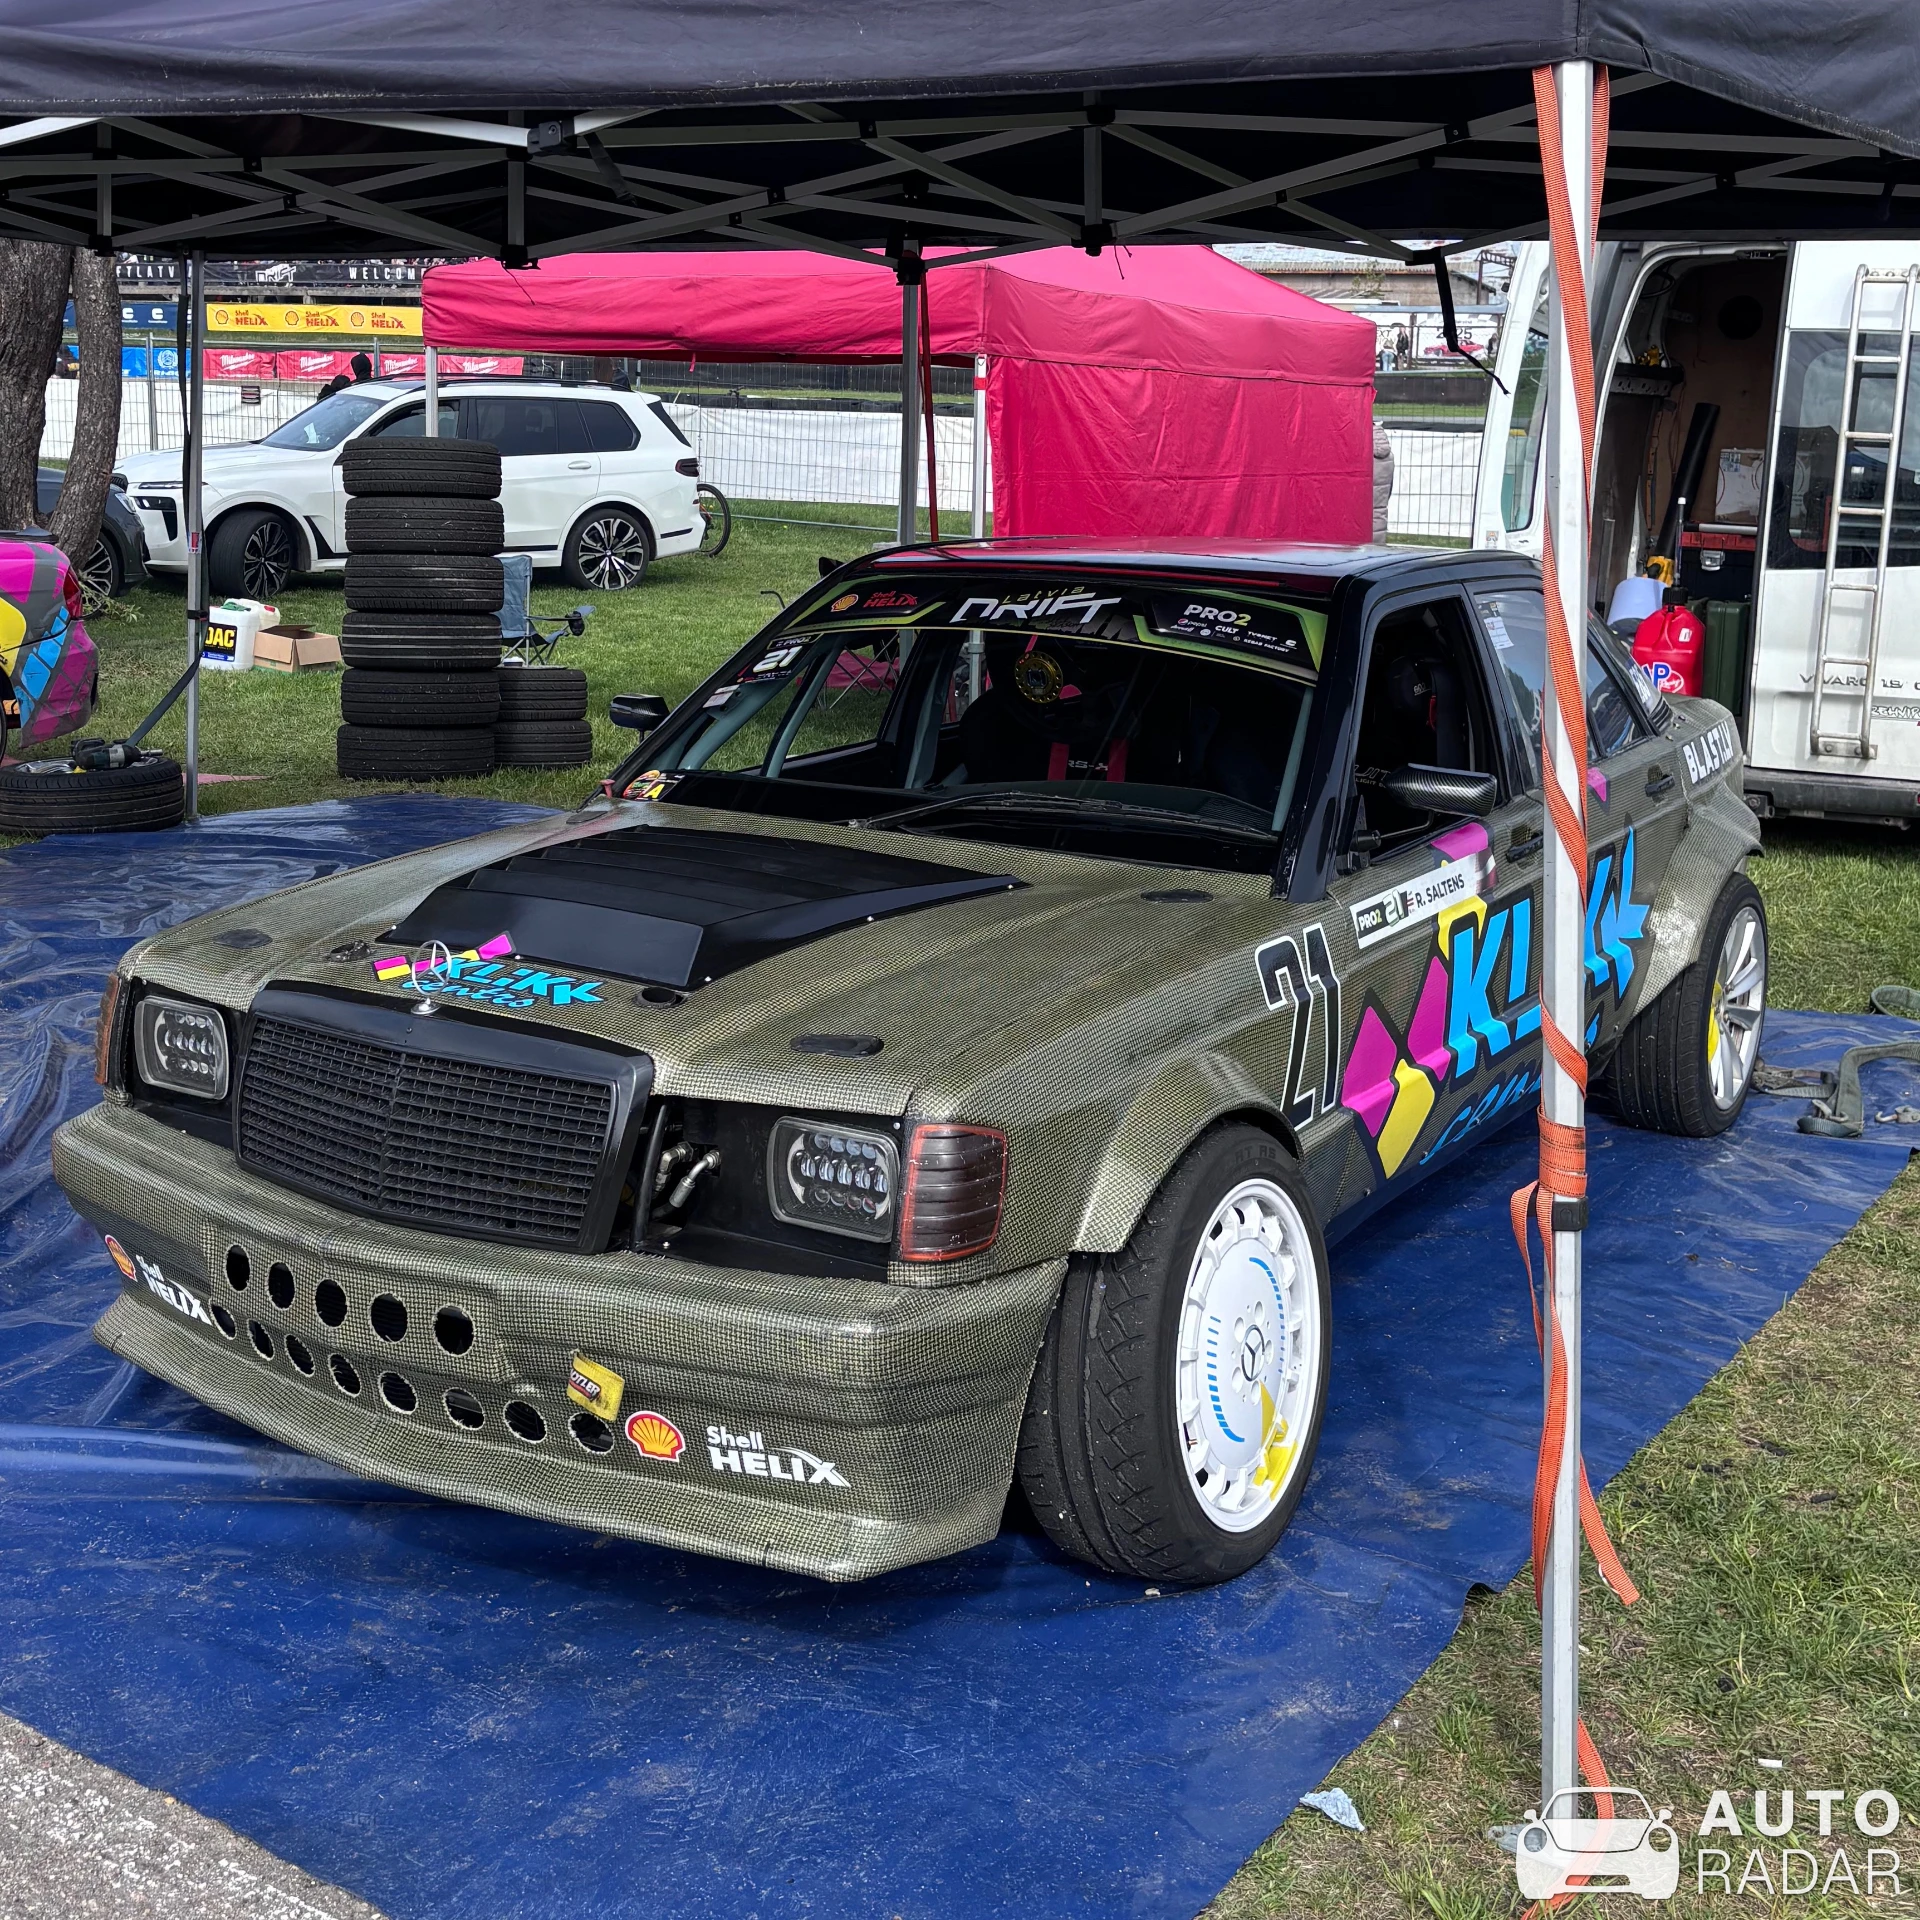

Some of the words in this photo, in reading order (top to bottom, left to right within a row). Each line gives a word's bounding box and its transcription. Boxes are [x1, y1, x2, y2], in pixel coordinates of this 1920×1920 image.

[235, 309, 249, 317] Shell
[235, 314, 268, 326] HELIX
[306, 315, 339, 327] HELIX
[371, 316, 406, 329] HELIX
[1436, 328, 1473, 339] 225
[863, 593, 918, 608] HELIX
[872, 591, 896, 599] Shell
[949, 592, 1122, 624] DRIFT
[1184, 604, 1251, 627] PRO2
[1215, 625, 1239, 634] CULT
[753, 645, 803, 673] 21
[1358, 908, 1383, 931] PRO2
[1382, 889, 1405, 927] 21
[1415, 891, 1426, 909] R.
[1426, 873, 1465, 904] SALTENS
[1254, 922, 1342, 1132] 21
[136, 1254, 164, 1282] Shell
[142, 1270, 213, 1326] HELIX
[706, 1425, 764, 1450] Shell
[707, 1446, 851, 1487] HELIX
